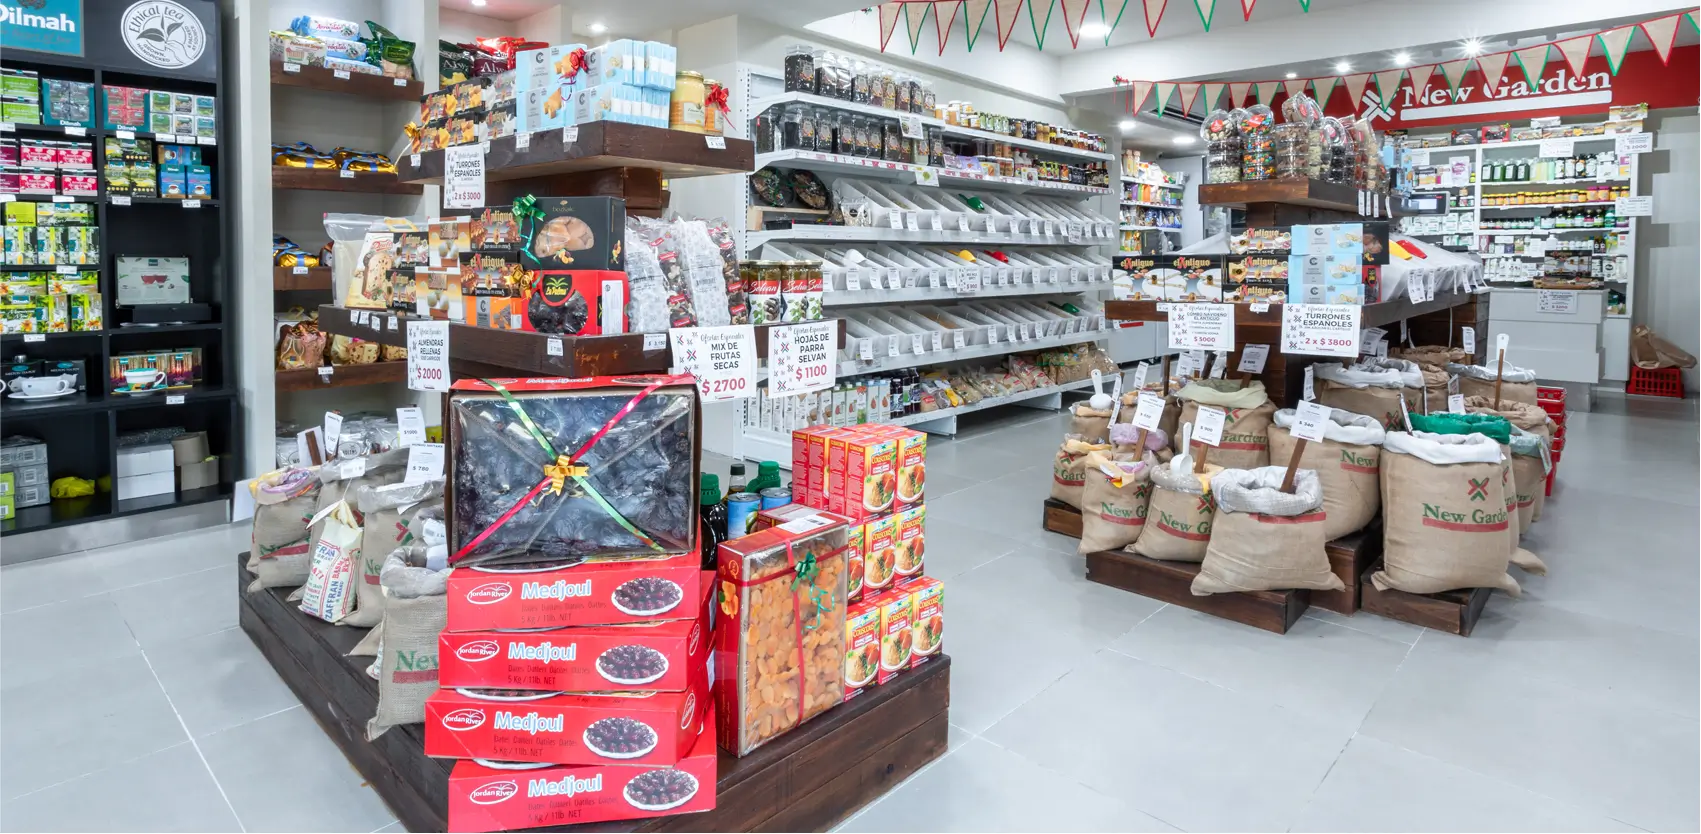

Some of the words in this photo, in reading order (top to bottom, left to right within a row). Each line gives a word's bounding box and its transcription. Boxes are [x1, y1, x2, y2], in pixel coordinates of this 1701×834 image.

[0, 3, 76, 33] Dilmah
[129, 5, 160, 33] Ethical
[164, 6, 185, 20] tea
[136, 43, 171, 63] HANDPICKED
[1401, 84, 1474, 107] New
[1483, 69, 1612, 99] Garden
[455, 160, 481, 169] TURRONES
[454, 167, 481, 177] ESPAÑOLES
[454, 192, 458, 200] 2
[462, 191, 467, 200] $
[467, 192, 481, 200] 3000
[749, 281, 777, 294] Selvan
[783, 280, 808, 293] Selva
[1303, 319, 1353, 327] ESPAÑOLES
[1305, 313, 1352, 321] TURRONES
[418, 339, 444, 347] ALMENDRAS
[794, 334, 819, 345] HOJAS
[819, 332, 830, 342] DE
[1319, 337, 1326, 346] $
[1327, 338, 1352, 347] 3800
[420, 347, 441, 356] RELLENAS
[711, 342, 727, 351] MIX
[727, 341, 739, 350] DE
[799, 343, 825, 354] PARRA
[710, 351, 741, 361] FRUTAS
[798, 352, 827, 364] SELVAN
[713, 360, 739, 370] SECAS
[417, 367, 422, 380] $
[423, 367, 442, 380] 2000
[796, 366, 803, 382] $
[804, 364, 827, 379] 1100
[701, 378, 711, 397] $
[713, 377, 746, 393] 2700
[1220, 429, 1268, 443] Garden
[1341, 449, 1374, 467] New
[1101, 501, 1132, 518] New
[1421, 502, 1467, 523] New
[1471, 508, 1508, 524] Garde
[1160, 510, 1192, 532] New
[364, 558, 381, 575] Ne
[521, 579, 592, 601] Medjoul
[324, 581, 339, 620] ZAFFRAN
[508, 642, 577, 664] Medjoul
[513, 676, 522, 686] Kg
[543, 676, 556, 685] NET
[445, 715, 466, 723] Jordan
[465, 717, 482, 725] River
[493, 711, 565, 735] Medjoul
[530, 748, 543, 757] NET
[527, 773, 603, 798] Medjoul
[472, 790, 496, 798] Jordan
[496, 789, 514, 797] River
[568, 809, 582, 818] NET
